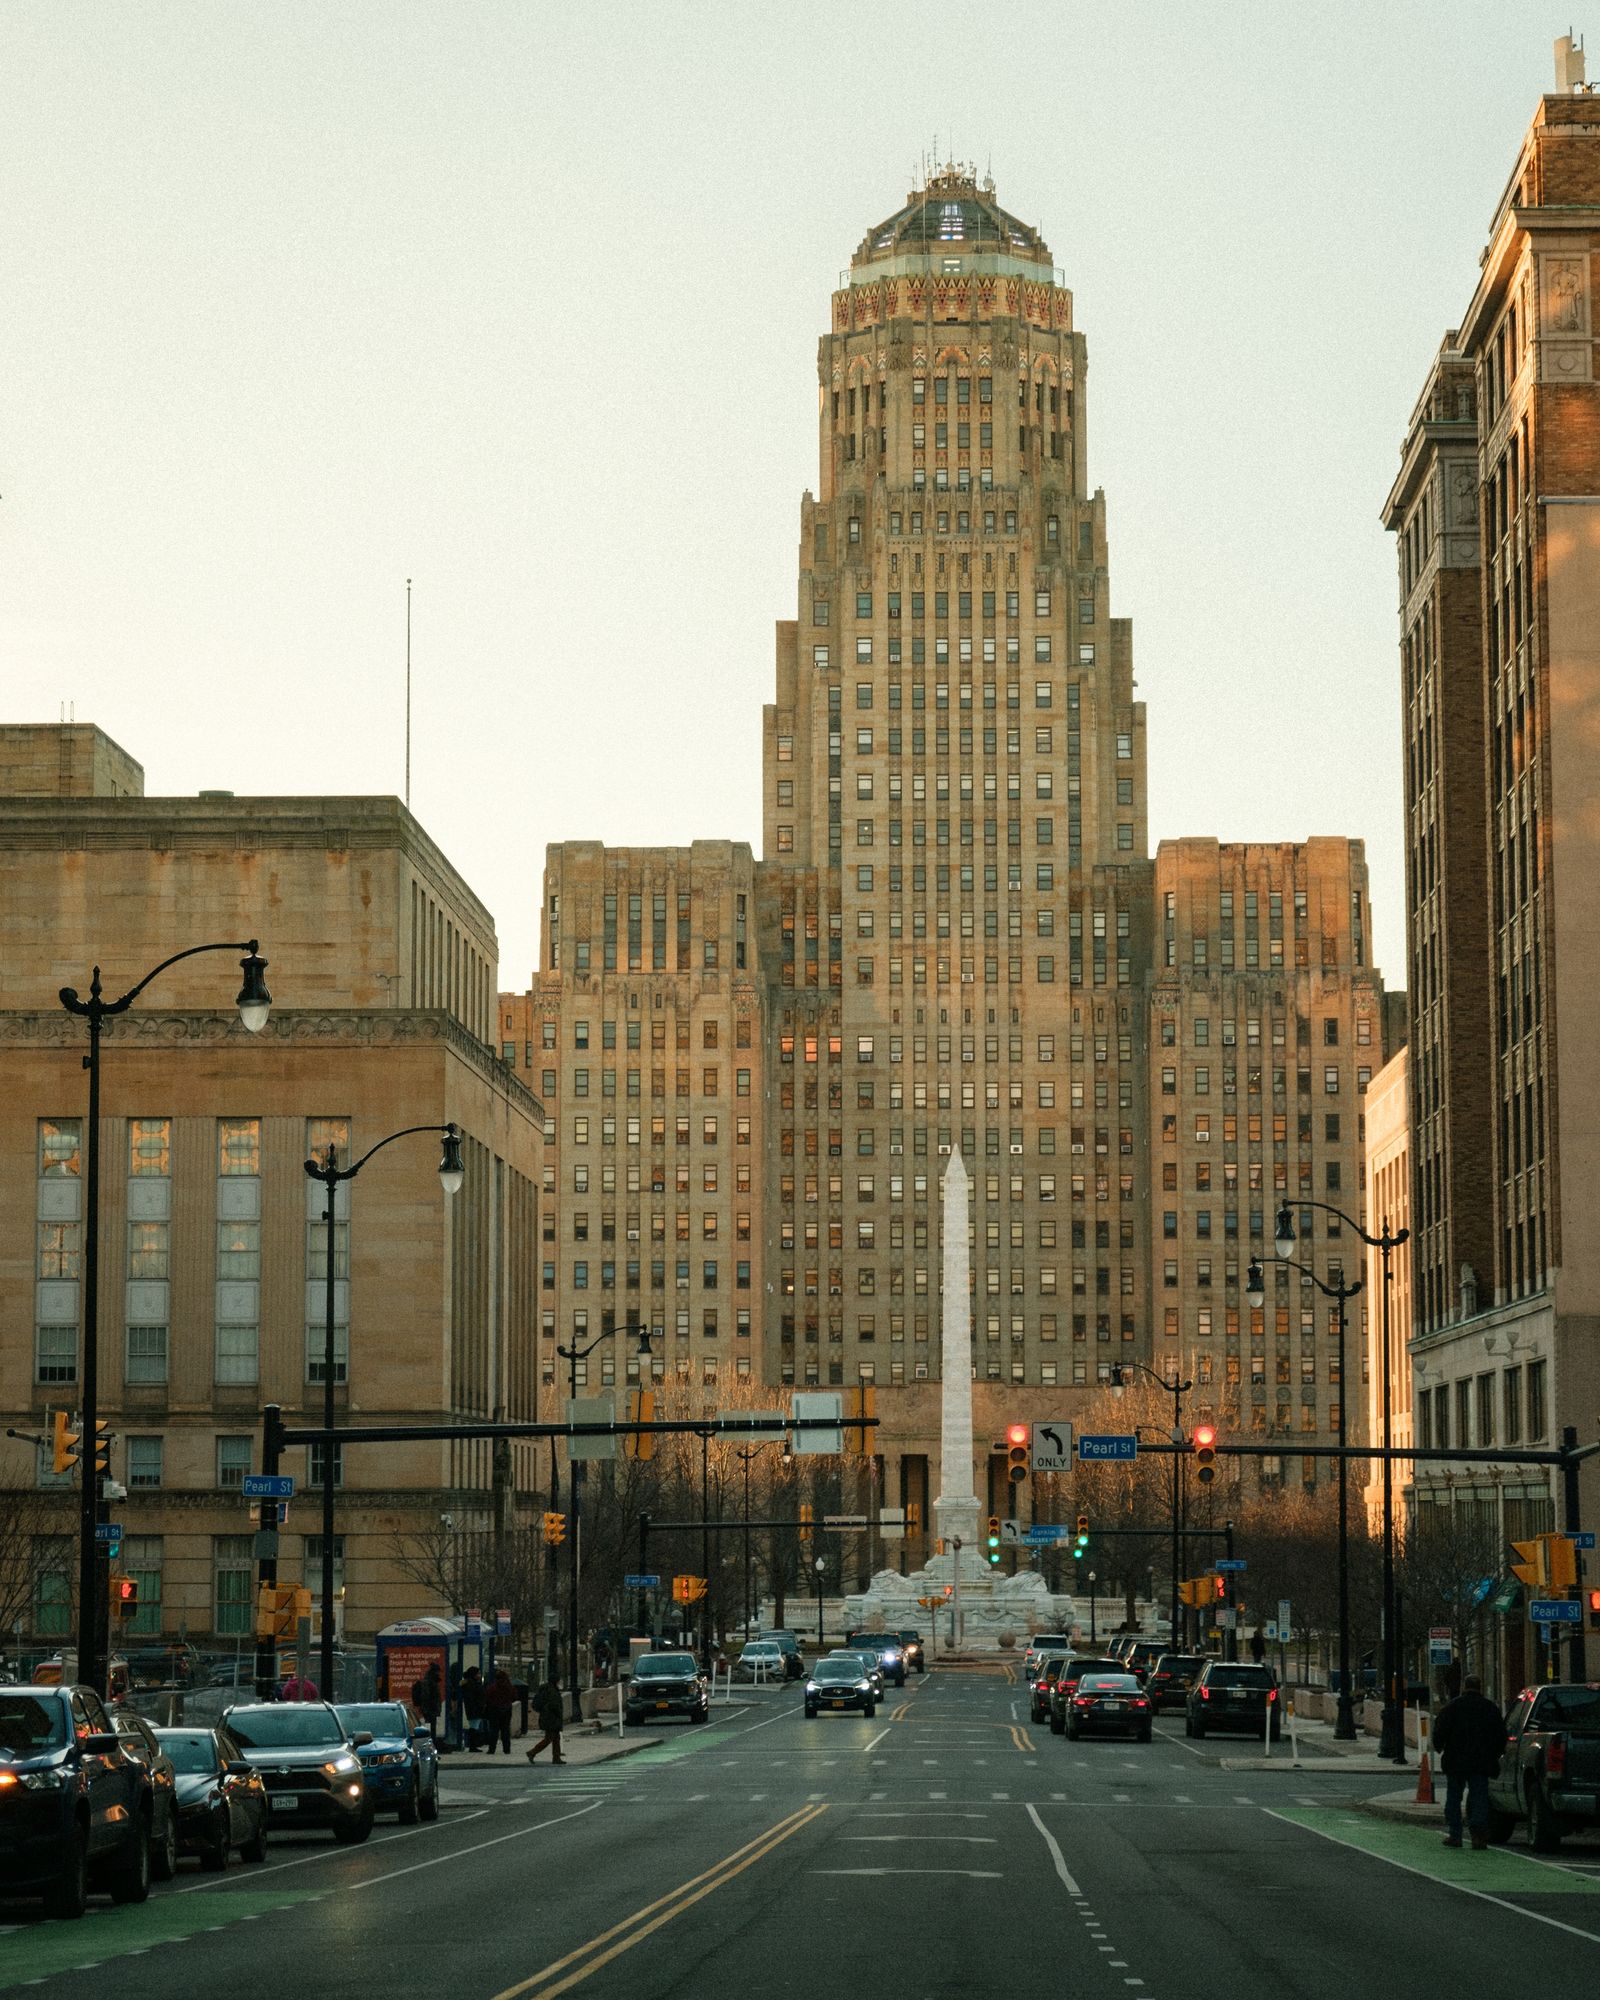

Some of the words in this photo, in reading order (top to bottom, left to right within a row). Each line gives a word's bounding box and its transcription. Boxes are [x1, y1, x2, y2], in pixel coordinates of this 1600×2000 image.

[1083, 1441, 1117, 1454] Pearl
[1121, 1443, 1131, 1453] St
[1037, 1458, 1067, 1467] ONLY
[245, 1480, 271, 1492] Pearl
[280, 1481, 290, 1492] St
[111, 1528, 120, 1536] St
[1585, 1537, 1593, 1545] St
[1532, 1605, 1559, 1617] Pearl
[1568, 1605, 1578, 1617] St
